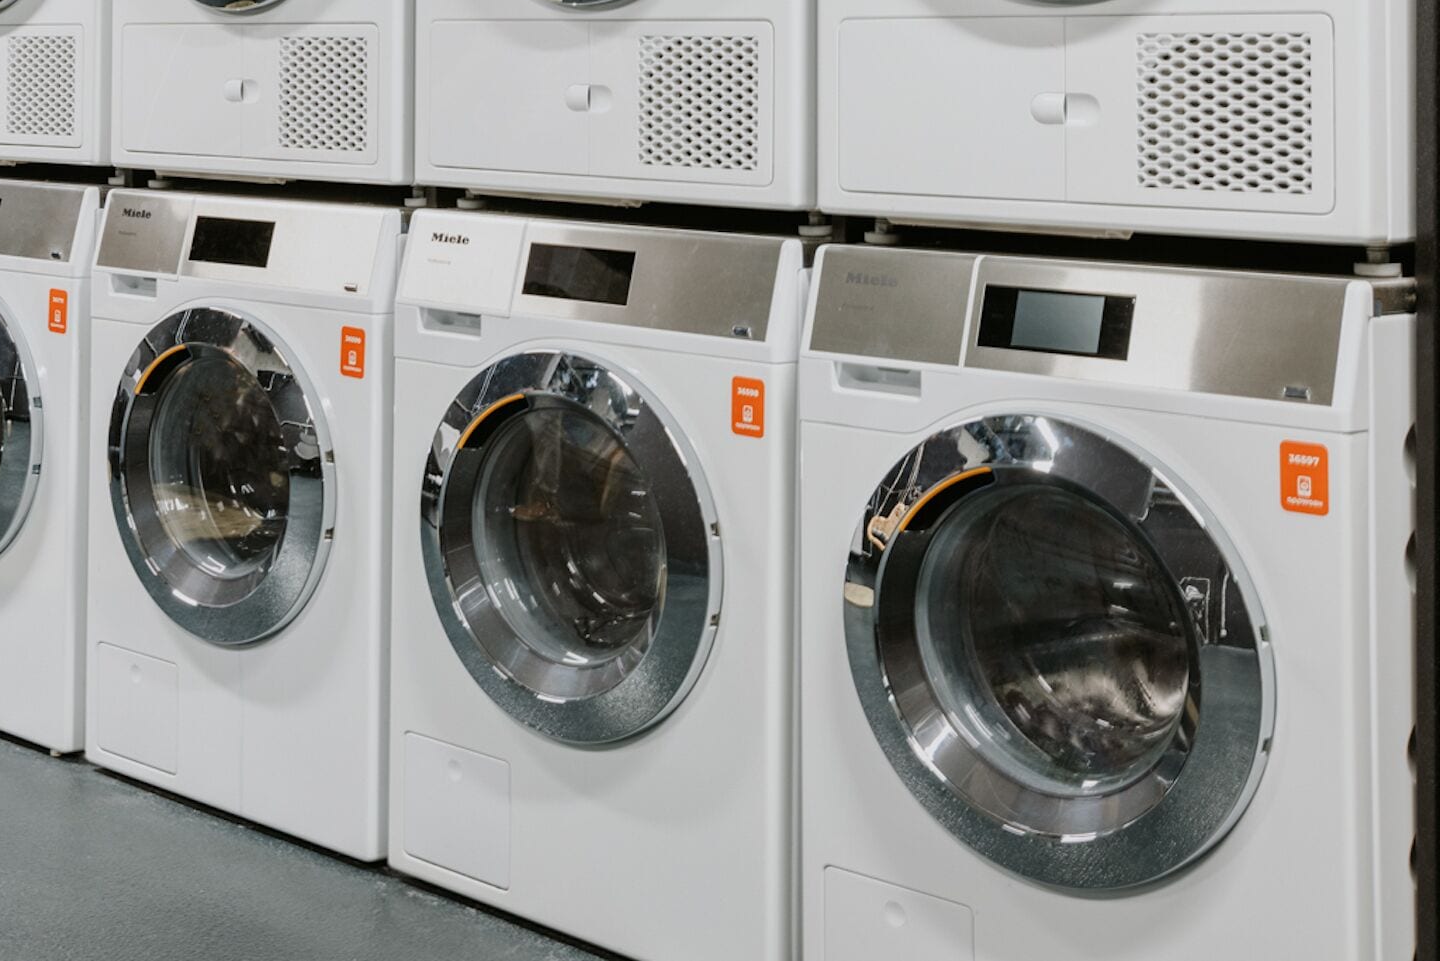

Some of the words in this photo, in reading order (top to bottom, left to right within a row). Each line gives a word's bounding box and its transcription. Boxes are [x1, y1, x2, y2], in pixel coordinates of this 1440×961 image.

[122, 207, 152, 219] Miele
[431, 231, 470, 245] Miele
[846, 271, 898, 288] Miele
